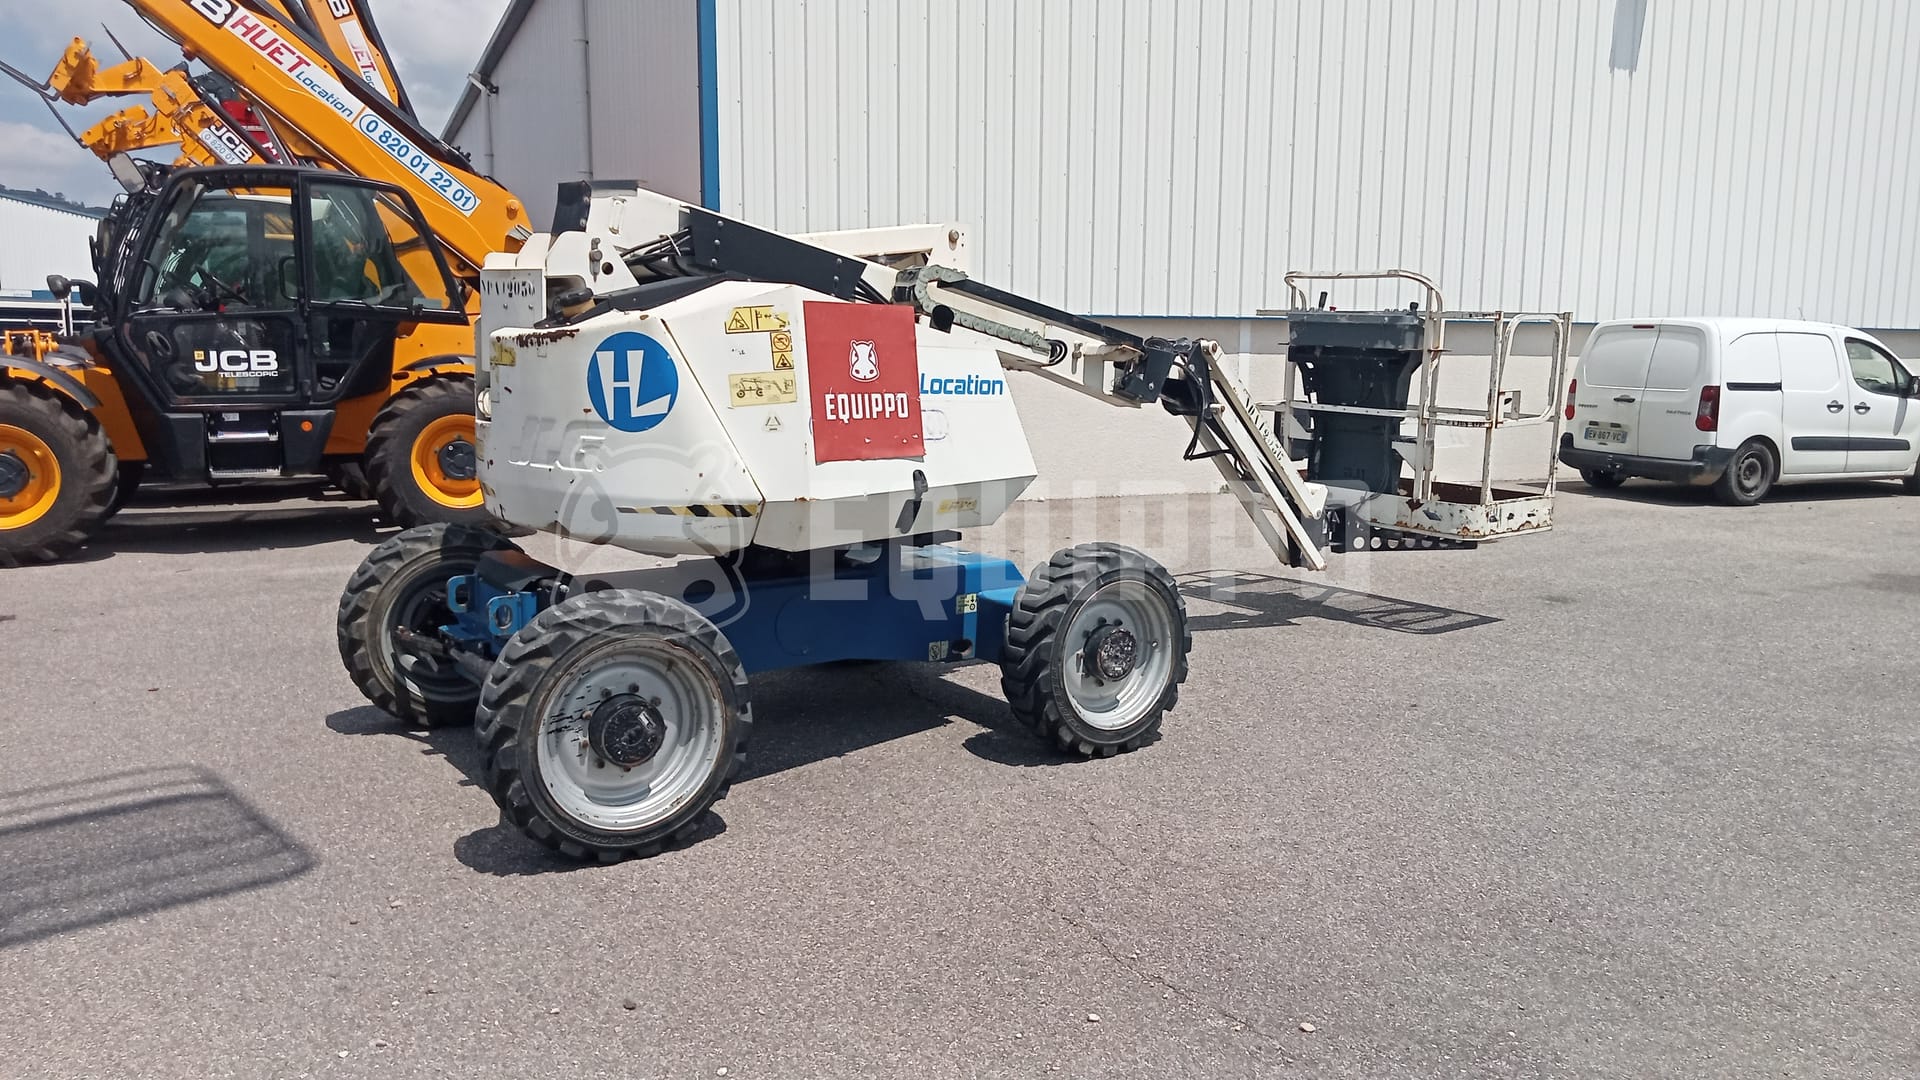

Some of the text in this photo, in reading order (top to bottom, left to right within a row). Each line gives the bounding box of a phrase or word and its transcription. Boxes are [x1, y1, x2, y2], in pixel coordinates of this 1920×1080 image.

[230, 15, 312, 73] HUET
[295, 70, 354, 118] Location
[209, 124, 253, 162] JCB
[210, 140, 227, 155] 820
[365, 119, 472, 208] 0 820 01 22 01
[194, 350, 278, 371] JCB
[596, 350, 671, 420] HL
[919, 372, 1004, 396] Location
[824, 393, 909, 424] EQUIPPO
